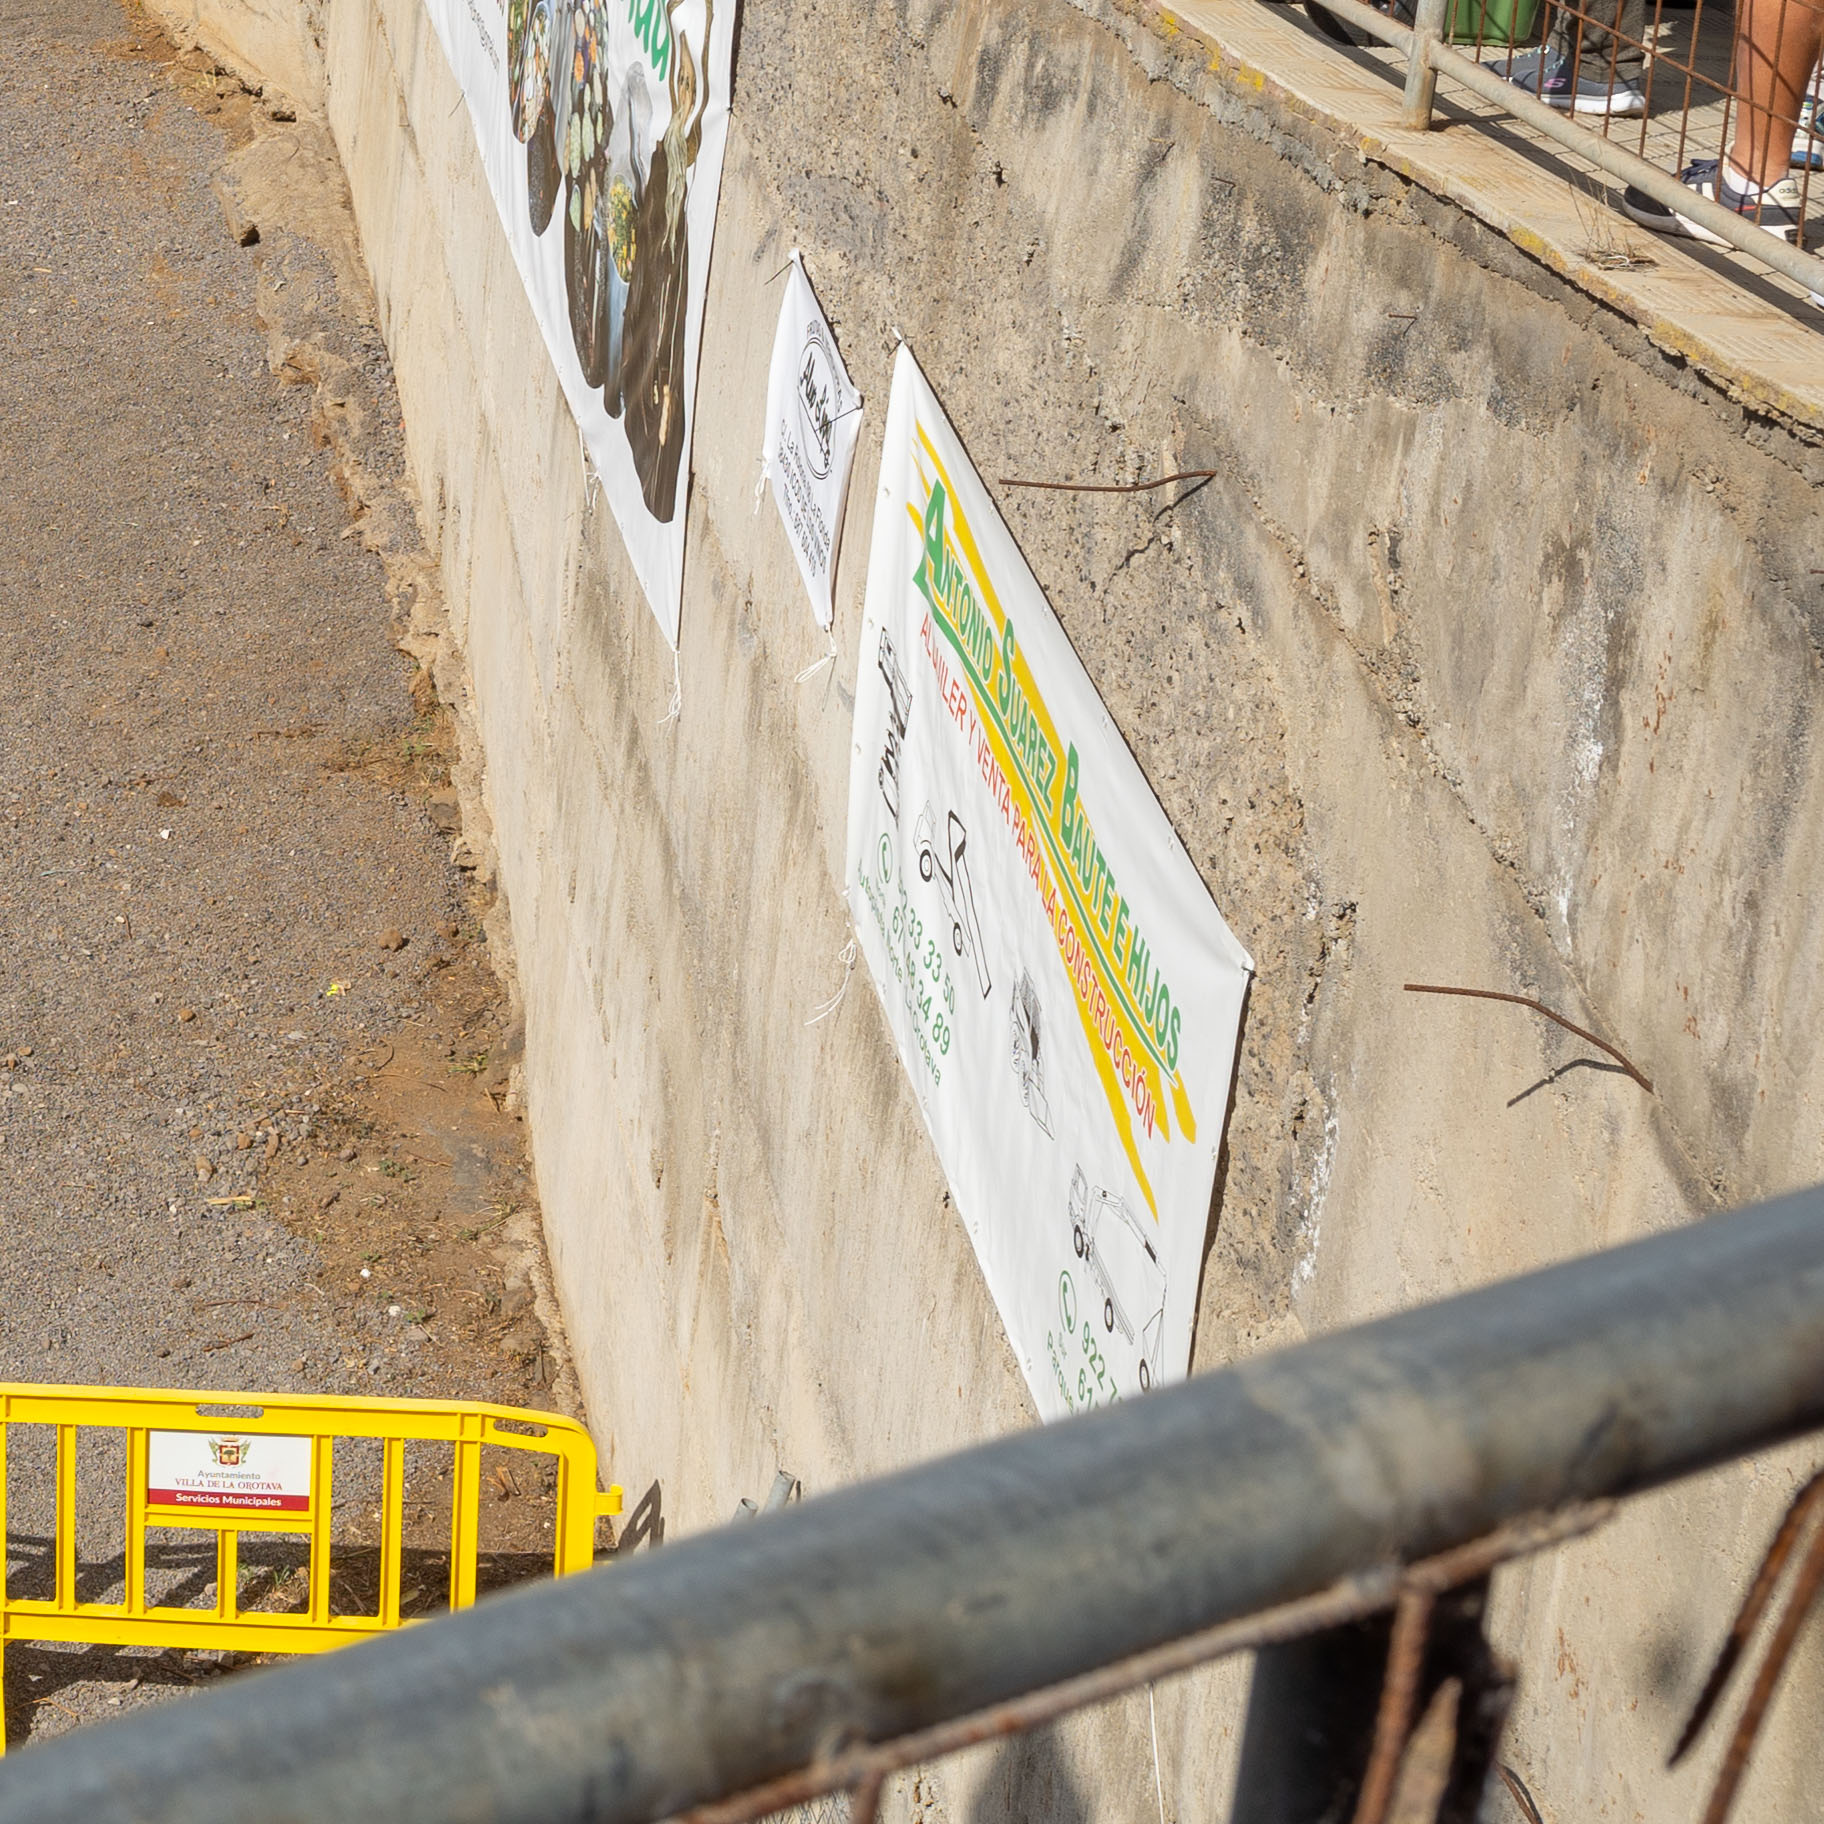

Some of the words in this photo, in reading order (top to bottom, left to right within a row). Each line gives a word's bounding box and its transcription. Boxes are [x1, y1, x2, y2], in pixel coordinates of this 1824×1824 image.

[924, 478, 993, 683] ANTONIO
[997, 617, 1058, 816] SUAREZ
[1058, 740, 1117, 937] BAUTE
[1113, 895, 1131, 969] E
[1126, 925, 1181, 1071] HIJOS
[967, 709, 978, 746] Y
[977, 733, 1012, 825] VENTA
[1011, 803, 1043, 892] PARA
[1041, 869, 1057, 928] LA
[1057, 907, 1157, 1140] CONSTRUCCIÓN
[923, 939, 943, 983] 33
[916, 979, 933, 1023] 34
[932, 1012, 951, 1056] 89
[1082, 1320, 1106, 1392] 922
[174, 1478, 205, 1488] VILLA
[206, 1479, 220, 1488] DE
[221, 1480, 233, 1489] LA
[235, 1481, 283, 1492] OROTAVA
[175, 1492, 219, 1505] Servicios
[221, 1494, 282, 1508] Municipales
[197, 1470, 261, 1481] Ayuntamiento
